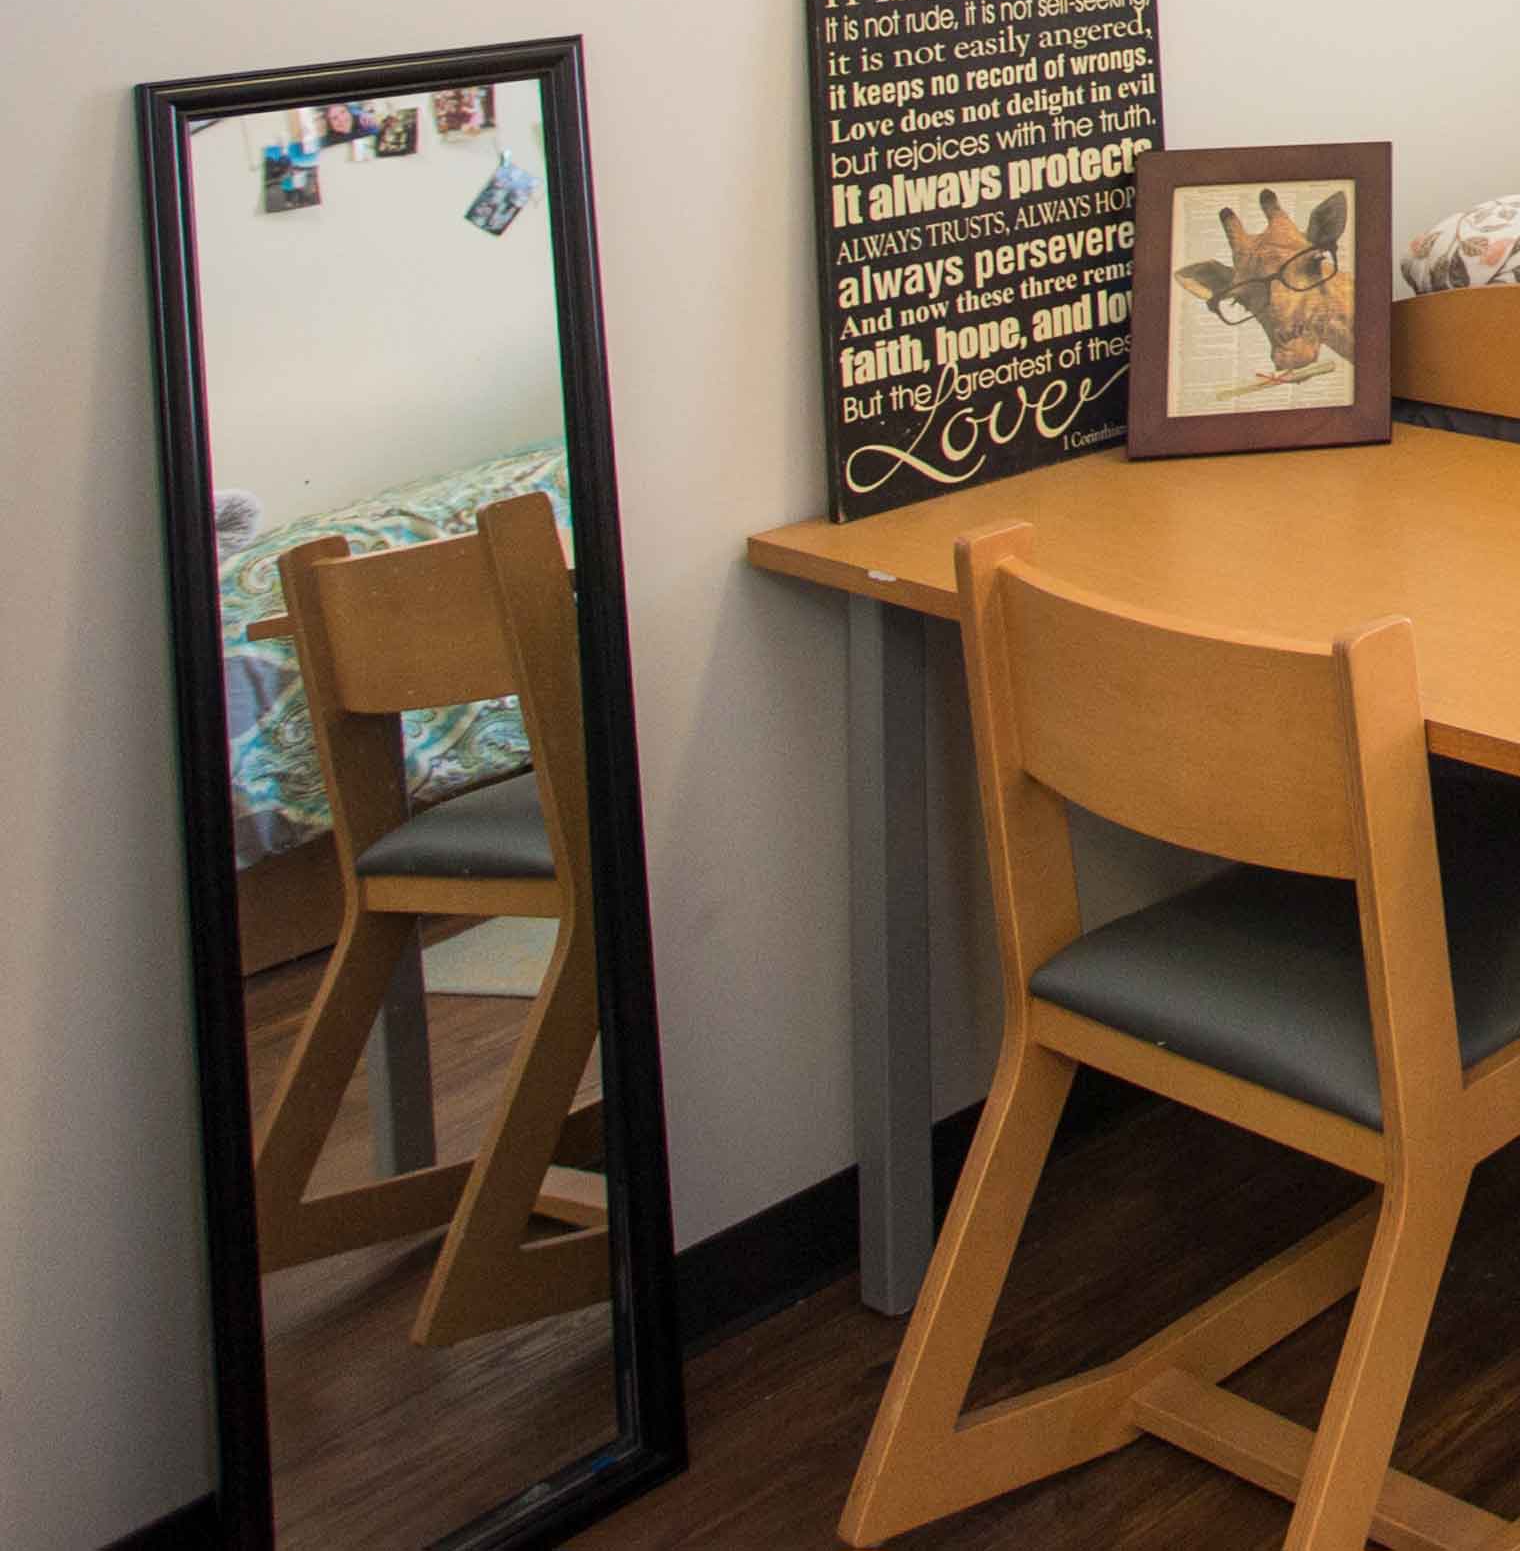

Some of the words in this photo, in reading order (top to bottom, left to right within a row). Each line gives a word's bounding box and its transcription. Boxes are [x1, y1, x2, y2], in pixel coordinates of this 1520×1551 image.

[826, 17, 838, 43] It
[844, 15, 859, 41] is
[864, 9, 900, 38] not
[906, 4, 958, 33] rude,
[965, 1, 976, 25] it
[981, 0, 995, 24] is
[828, 52, 850, 76] it
[861, 47, 883, 72] is
[893, 43, 946, 67] not
[954, 25, 1029, 59] easily
[1039, 7, 1152, 49] angered,
[829, 84, 846, 110] it
[853, 78, 924, 107] keeps
[931, 73, 958, 96] no
[967, 57, 1037, 90] record
[1045, 53, 1064, 80] of
[1070, 47, 1153, 75] wrongs.
[830, 118, 894, 144] Love
[901, 109, 955, 132] does
[961, 98, 1000, 123] not
[1007, 86, 1085, 115] delight
[1091, 82, 1112, 102] in
[1118, 73, 1156, 98] evil
[832, 147, 878, 178] but
[886, 135, 990, 171] rejoices
[996, 121, 1045, 149] with
[1052, 116, 1093, 140] the
[1099, 104, 1156, 133] truth.
[832, 184, 863, 228] It
[869, 165, 1002, 221] always
[836, 227, 922, 265] ALWAYS
[926, 211, 1010, 247] TRUSTS,
[1014, 195, 1091, 230] ALWAYS
[1095, 186, 1136, 214] HOP
[838, 255, 964, 309] always
[975, 220, 1135, 288] persevere
[840, 307, 893, 340] And
[900, 301, 949, 326] now
[956, 287, 1014, 313] these
[1020, 273, 1077, 299] three
[840, 334, 931, 388] faith,
[936, 316, 1028, 365] hope,
[1032, 293, 1092, 342] and
[844, 390, 883, 424] But
[889, 384, 931, 411] the
[954, 349, 1053, 400] greatest
[1059, 341, 1082, 368] of
[1088, 335, 1132, 361] thes
[846, 361, 1129, 493] Love
